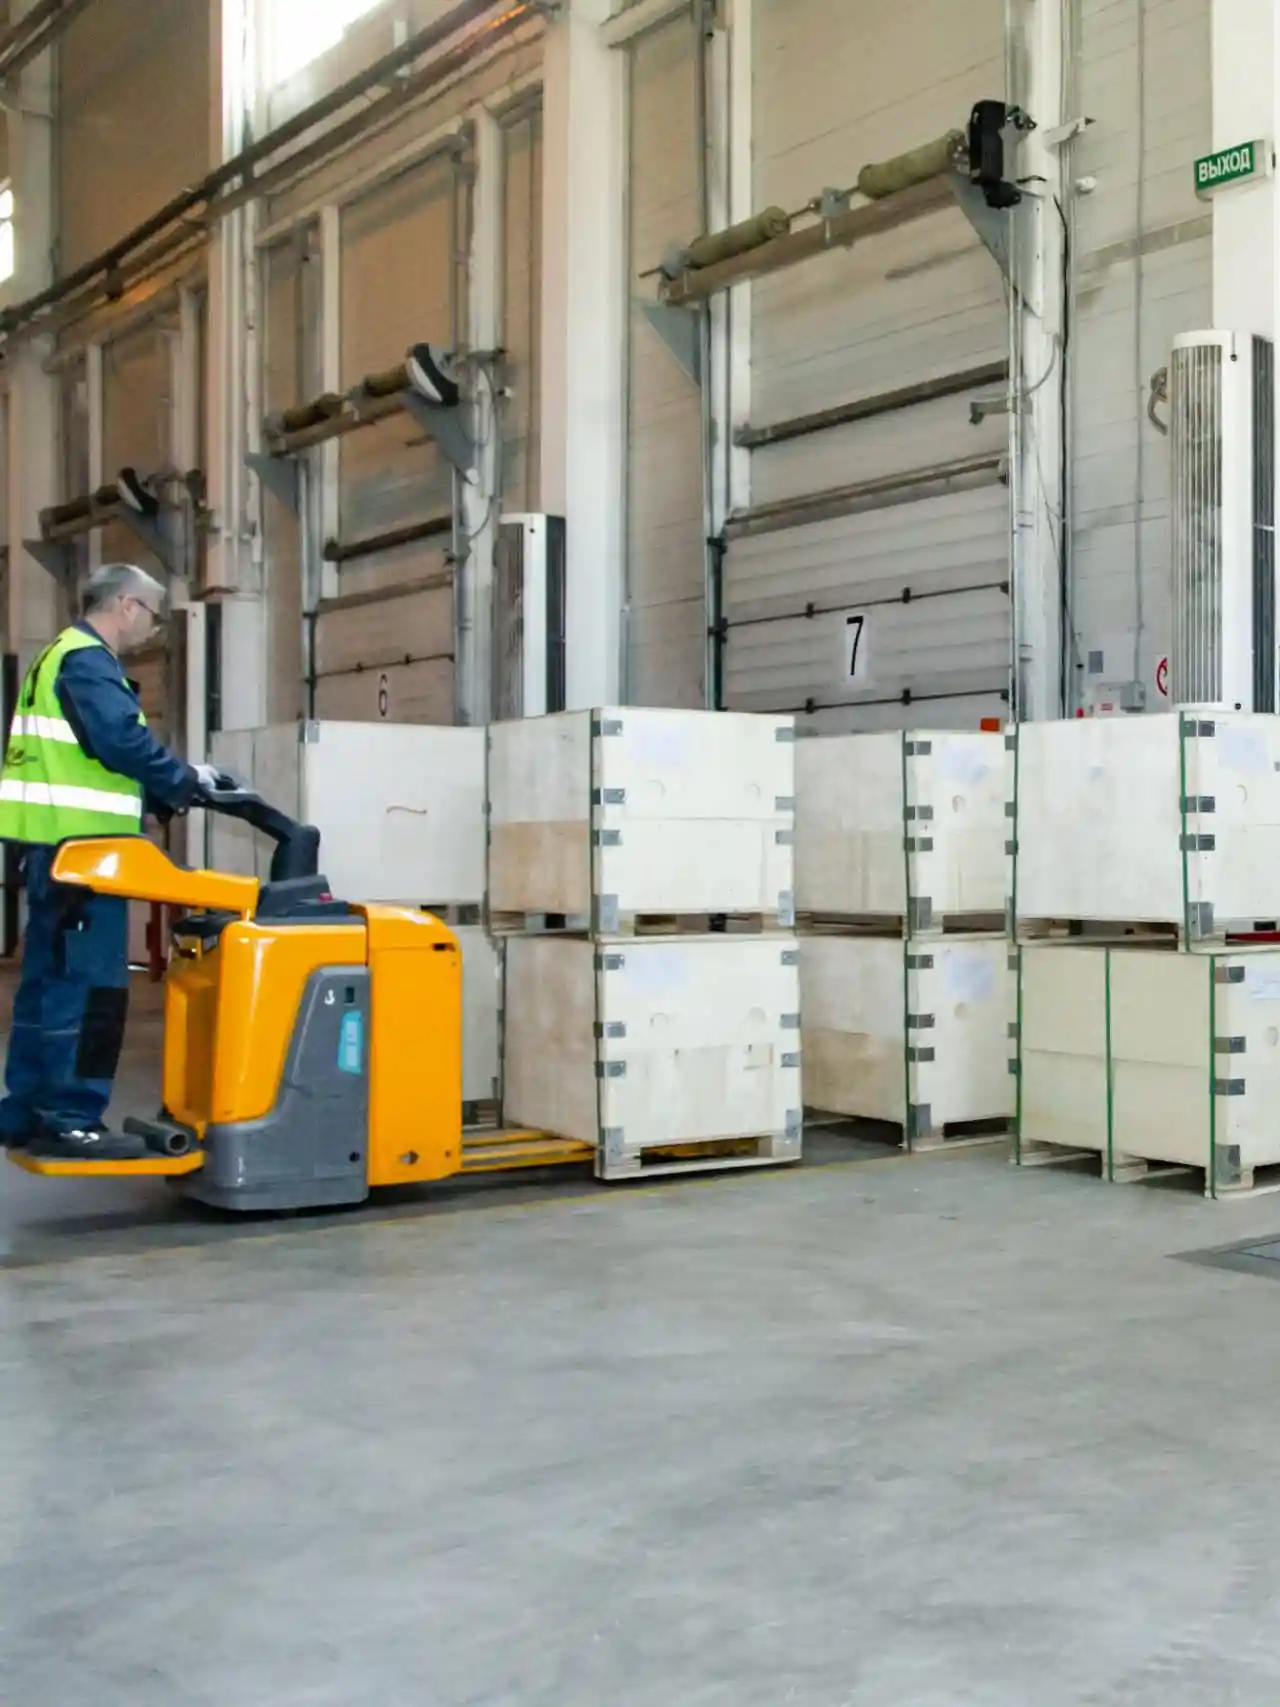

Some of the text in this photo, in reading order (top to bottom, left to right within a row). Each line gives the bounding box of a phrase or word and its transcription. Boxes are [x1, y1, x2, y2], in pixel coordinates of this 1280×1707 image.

[1199, 148, 1251, 182] ВЫХОД
[847, 616, 864, 676] 7
[378, 673, 388, 717] 6
